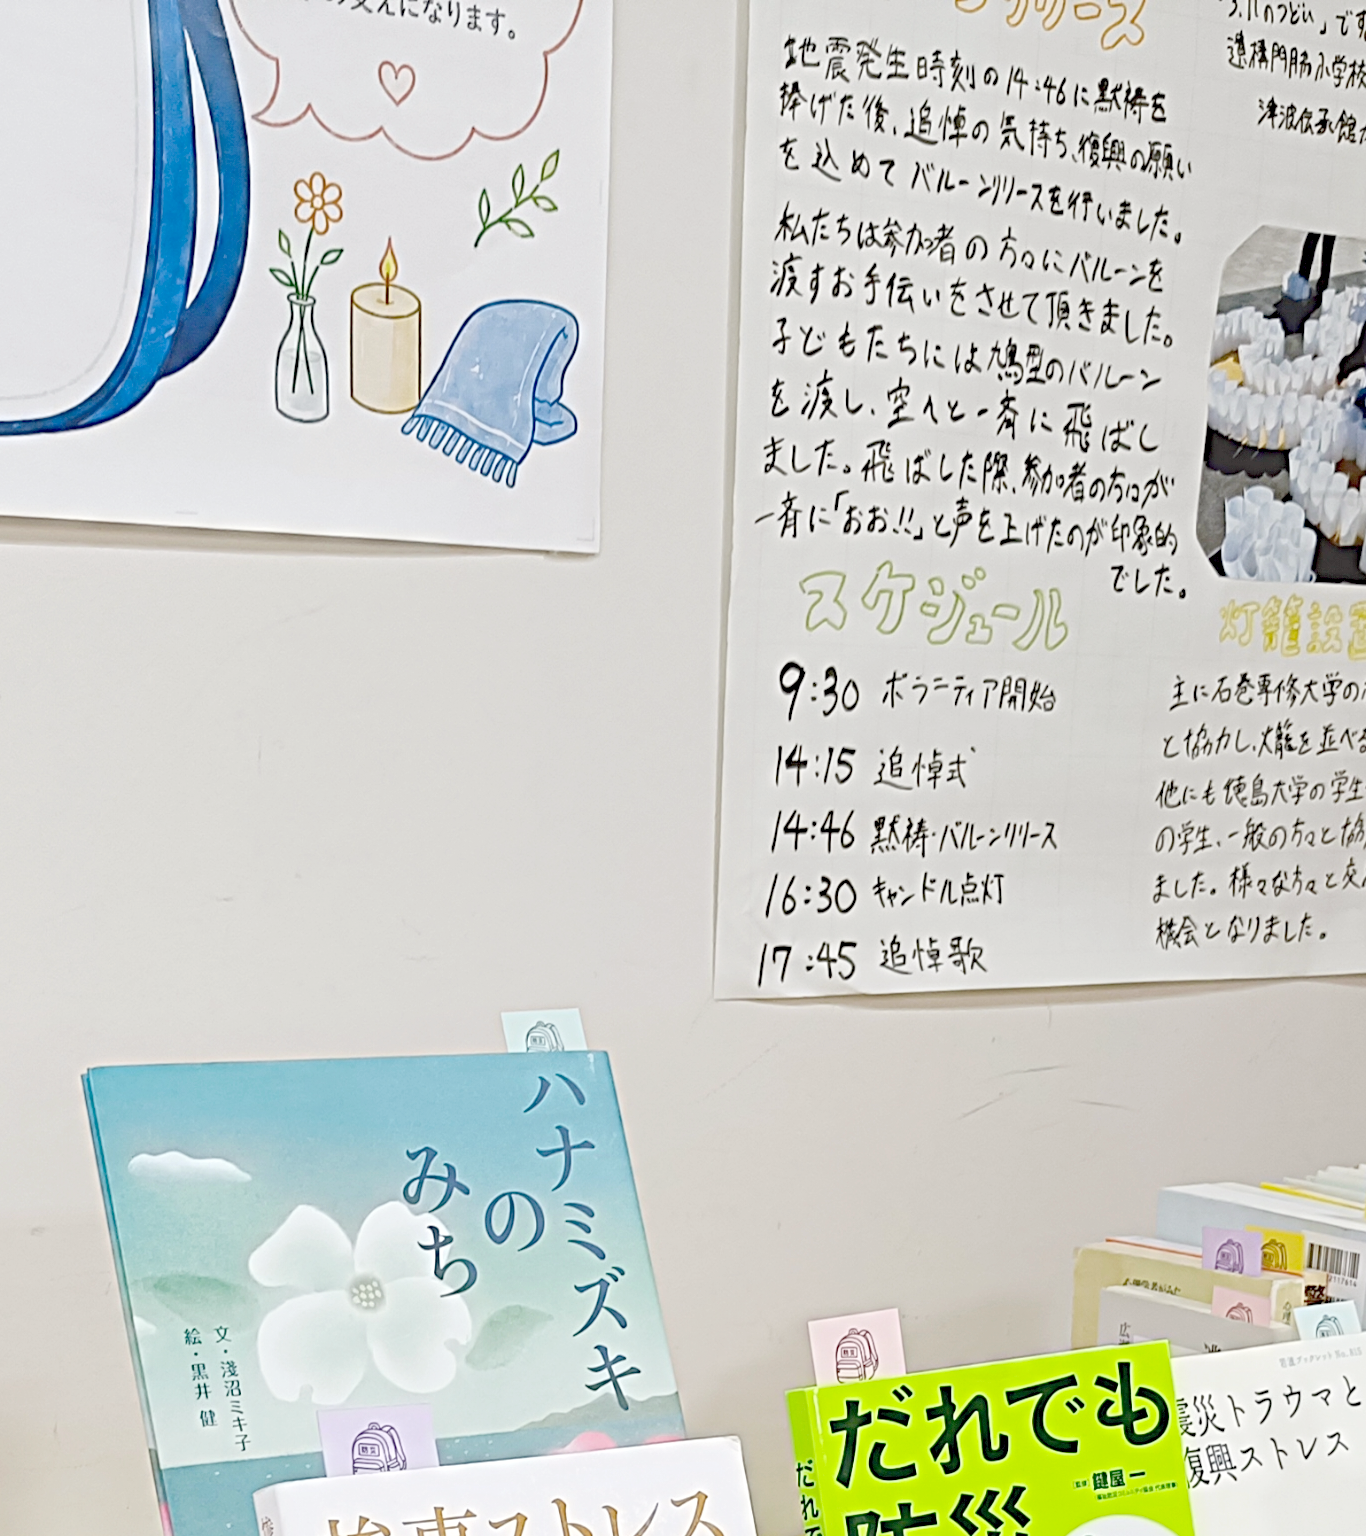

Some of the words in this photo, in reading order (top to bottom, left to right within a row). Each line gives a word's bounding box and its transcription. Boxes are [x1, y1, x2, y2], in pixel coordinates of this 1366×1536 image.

[799, 560, 1068, 651] スケジュール
[1110, 564, 1188, 599] でした。
[778, 661, 860, 721] 9:30
[775, 743, 857, 786] 14:15
[873, 747, 977, 791] 追悼式
[771, 808, 856, 853] 14:46
[765, 873, 858, 919] 16:30
[871, 871, 1005, 909] キャンドル点灯
[757, 941, 857, 988] 17:45
[879, 934, 988, 975] 追悼歌
[1154, 912, 1327, 951] 機会となりました。
[402, 1145, 478, 1299] みち
[484, 1190, 546, 1252] の
[522, 1072, 642, 1412] ハナミズキ
[184, 1327, 213, 1400] 絵・黒井
[199, 1409, 218, 1427] 健
[828, 1361, 1170, 1490] だれでも
[1183, 1429, 1351, 1490] 復興ストレス
